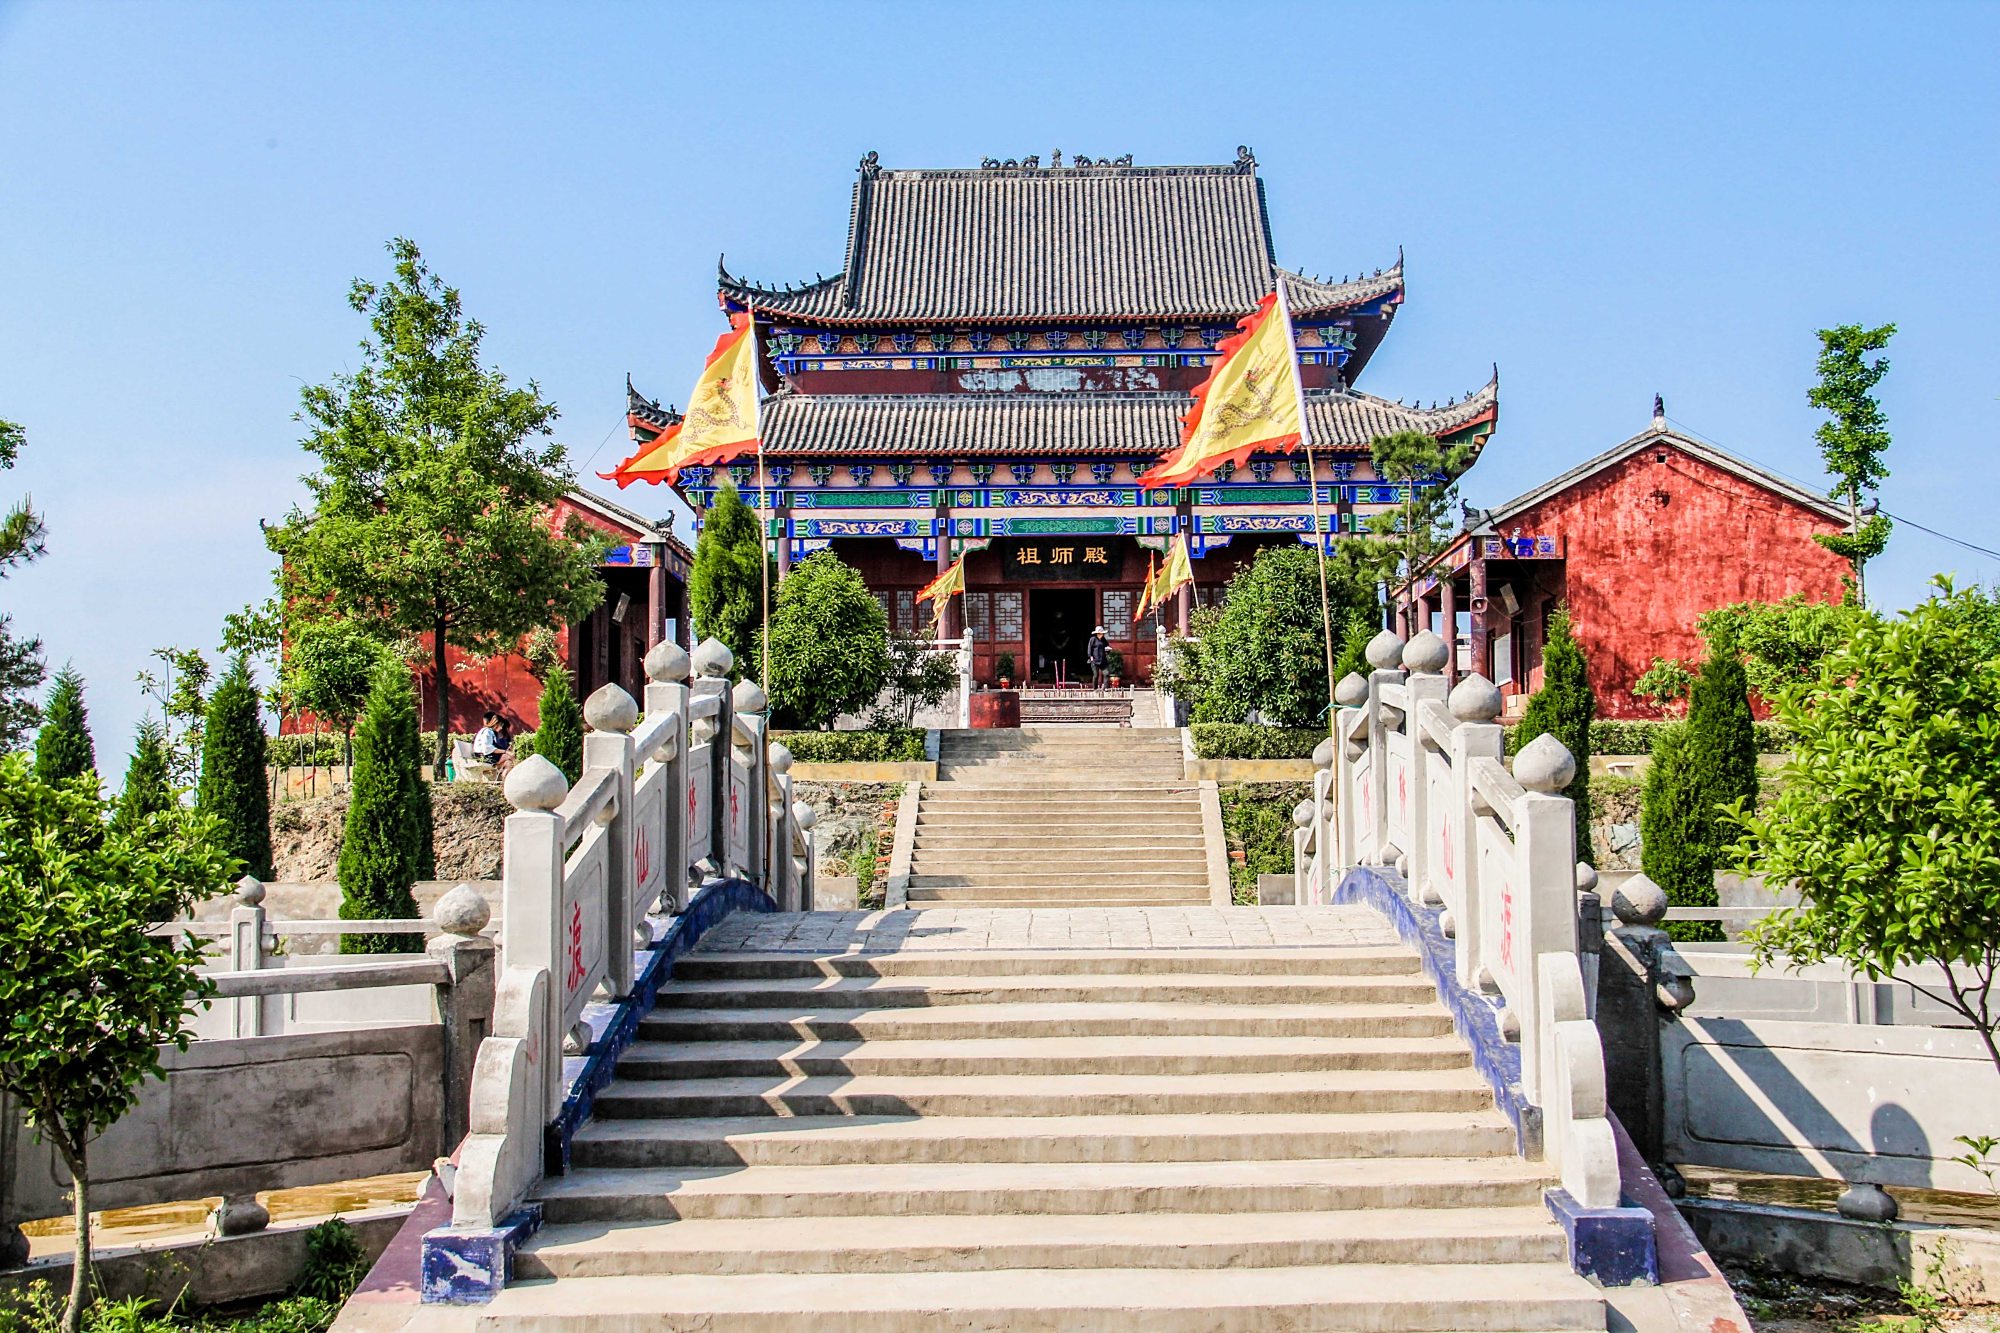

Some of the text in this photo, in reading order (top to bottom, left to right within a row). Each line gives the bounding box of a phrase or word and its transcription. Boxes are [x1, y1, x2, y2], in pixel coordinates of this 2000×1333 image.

[1016, 547, 1108, 565] 祖师殿
[634, 824, 649, 889] 仙
[567, 900, 586, 993] 渡
